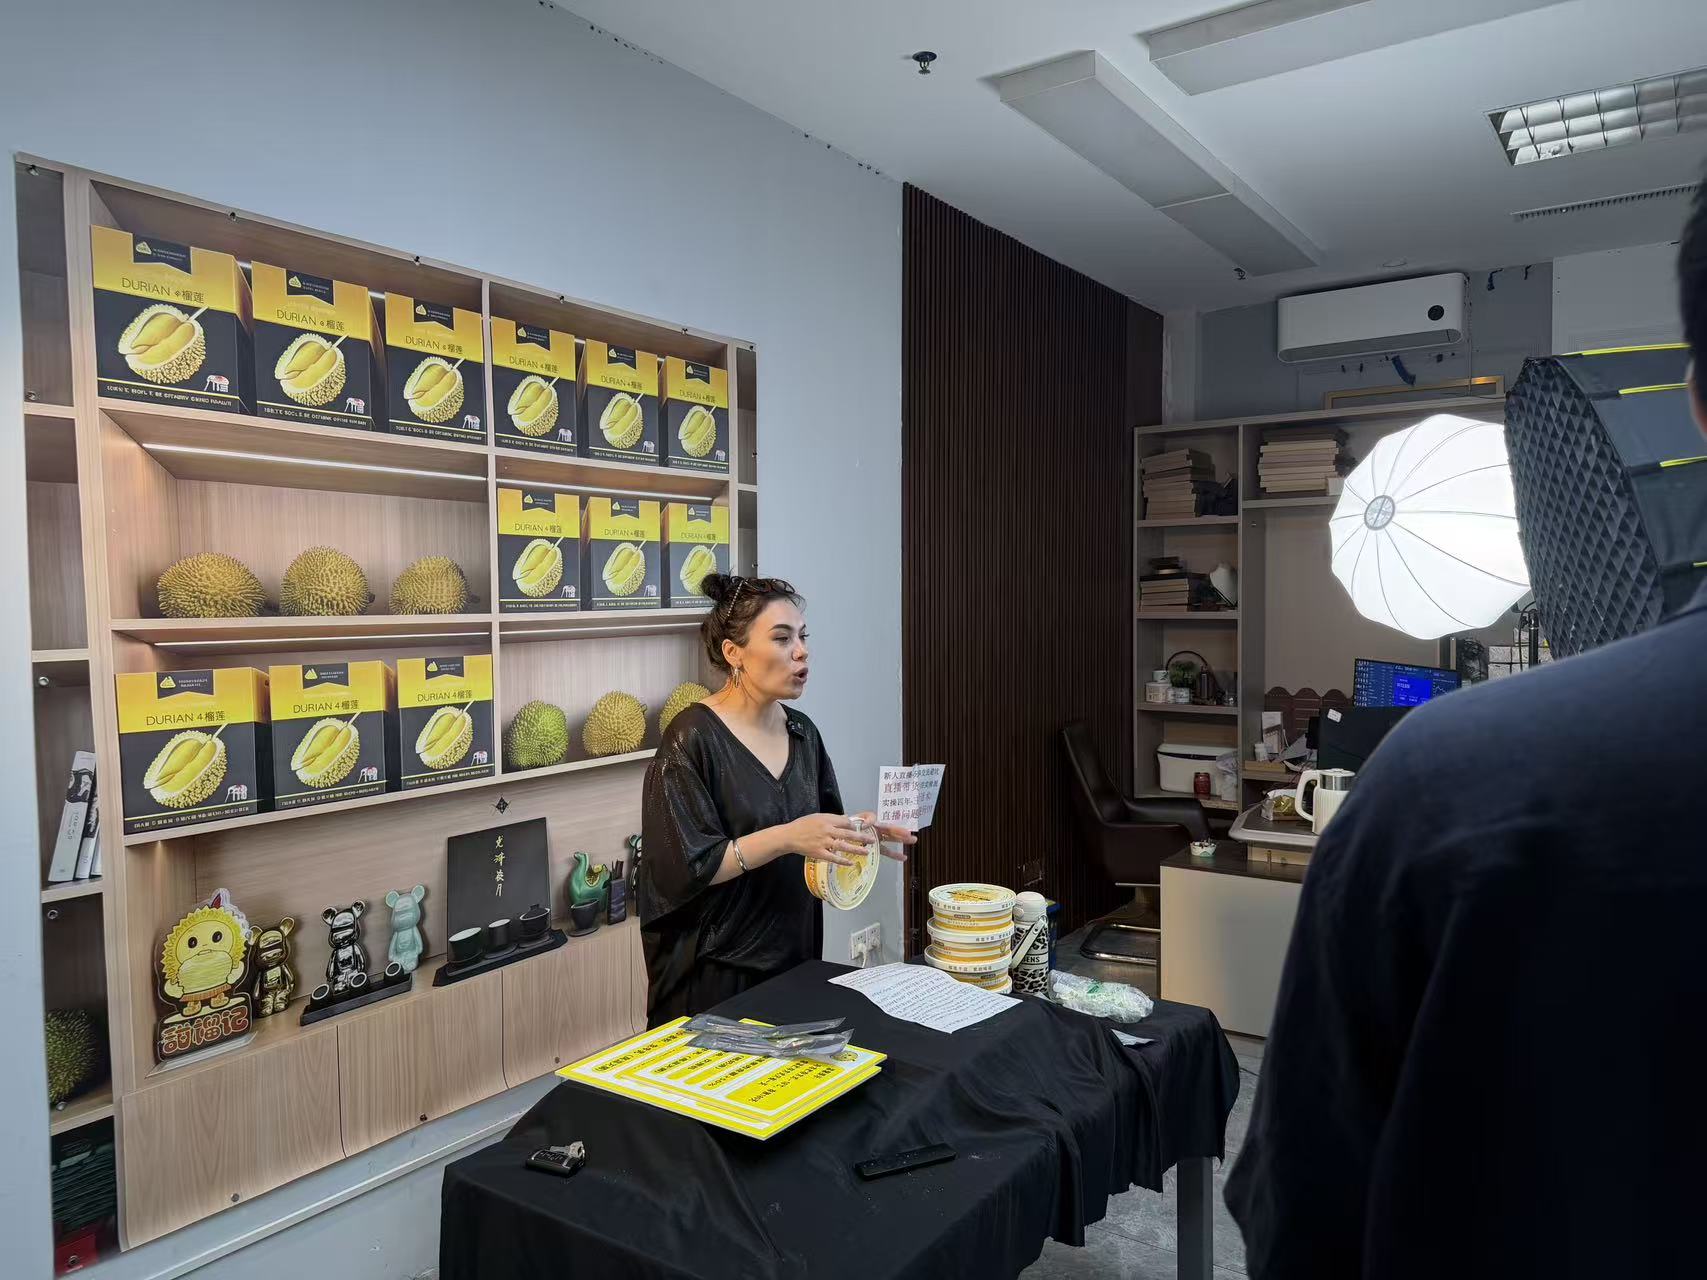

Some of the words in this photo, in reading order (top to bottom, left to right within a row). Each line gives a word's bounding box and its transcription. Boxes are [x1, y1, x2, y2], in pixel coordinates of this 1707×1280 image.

[121, 277, 171, 297] DURIAN
[182, 290, 204, 304] 榴莲
[276, 308, 317, 326] DURIAN
[325, 319, 345, 332] 榴莲
[405, 335, 440, 351] DURIAN
[509, 354, 539, 369] DURIAN
[600, 374, 627, 387] DURIAN
[514, 523, 544, 533] DURIAN
[604, 528, 629, 537] DURIAN
[417, 691, 450, 702] DURIAN
[293, 702, 333, 714] DURIAN
[146, 713, 194, 726] DURIAN
[204, 710, 226, 722] 榴莲
